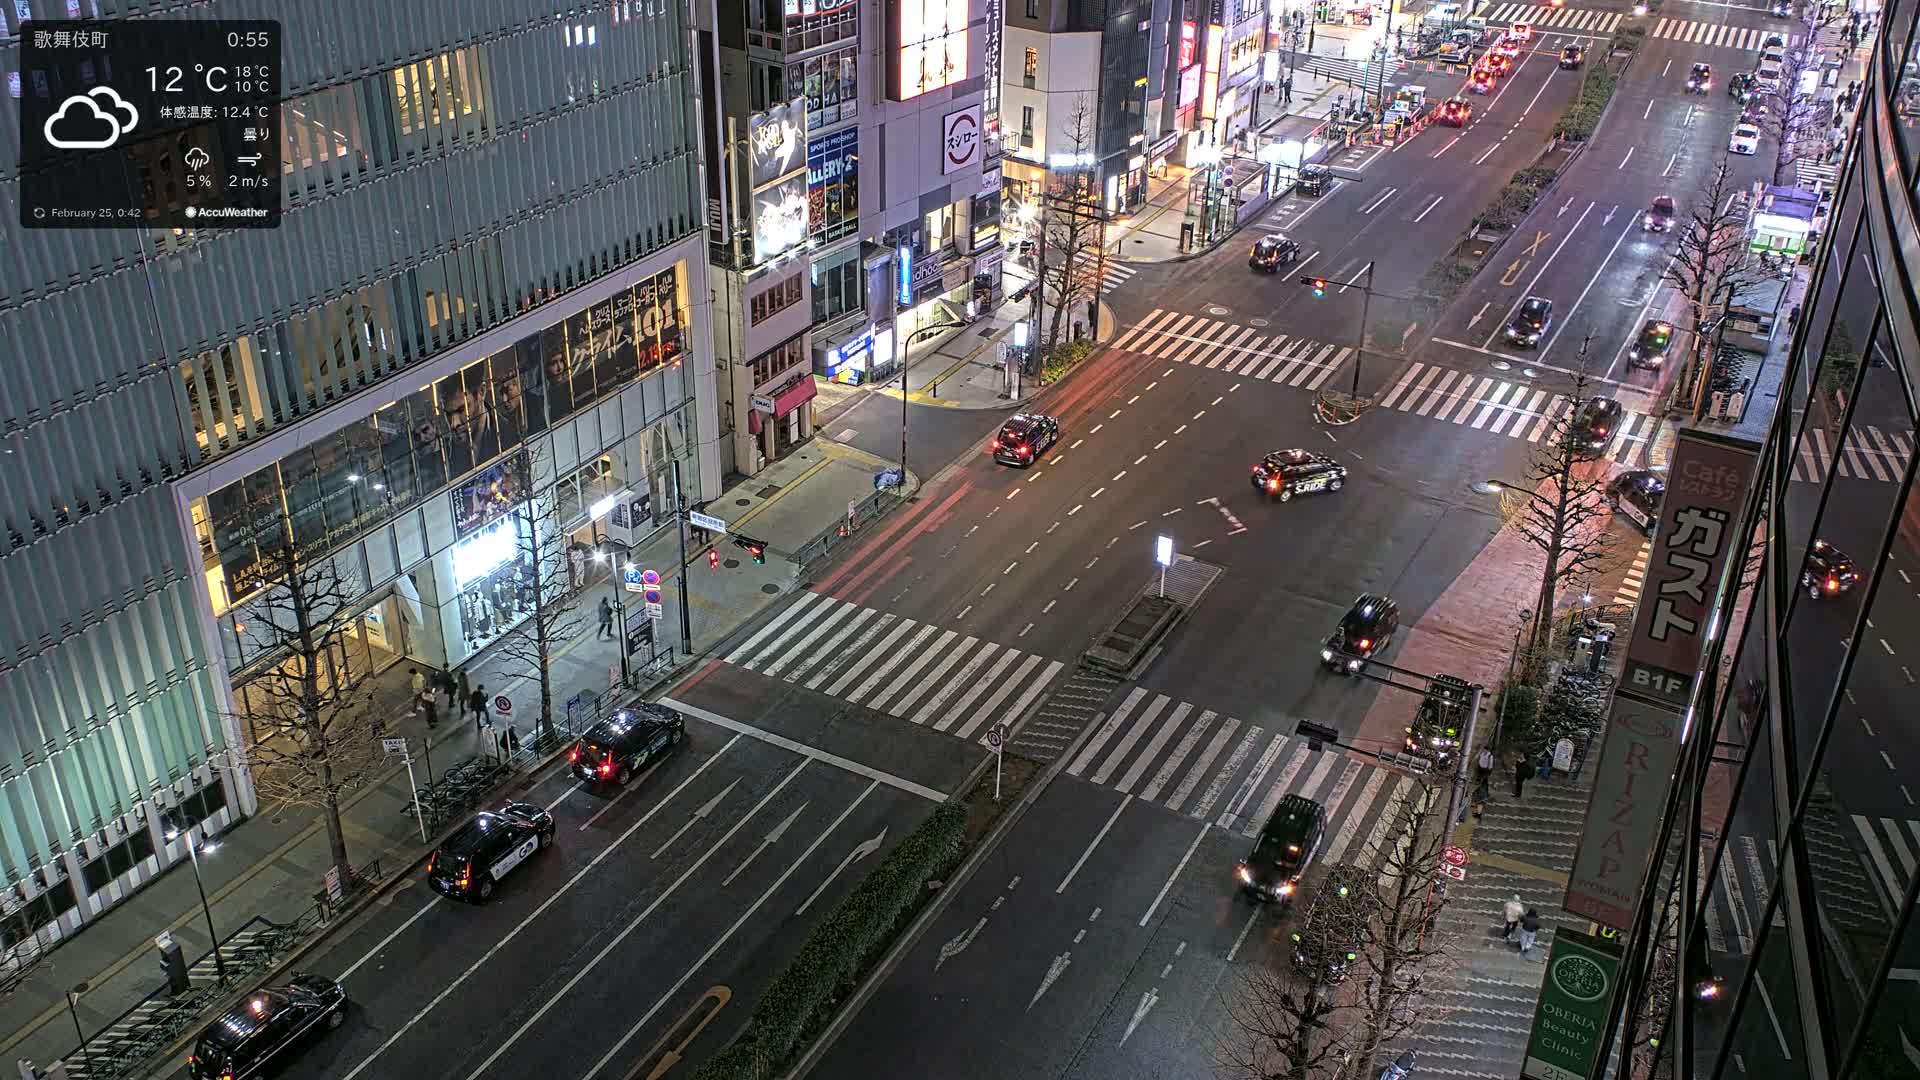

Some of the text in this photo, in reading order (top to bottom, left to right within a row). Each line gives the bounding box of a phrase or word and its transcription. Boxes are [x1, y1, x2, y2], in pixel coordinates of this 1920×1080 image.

[947, 132, 978, 151] スシロー
[709, 198, 721, 232] MUJI
[1683, 460, 1740, 488] Café
[1651, 508, 1727, 639] ガスト
[1633, 668, 1682, 693] B1F
[1599, 741, 1649, 879] RIZAP
[1559, 968, 1599, 989] OBERIA
[1542, 1003, 1596, 1031] OBERIA
[1543, 1018, 1589, 1044] Beauty
[1542, 1037, 1583, 1061] Clinic
